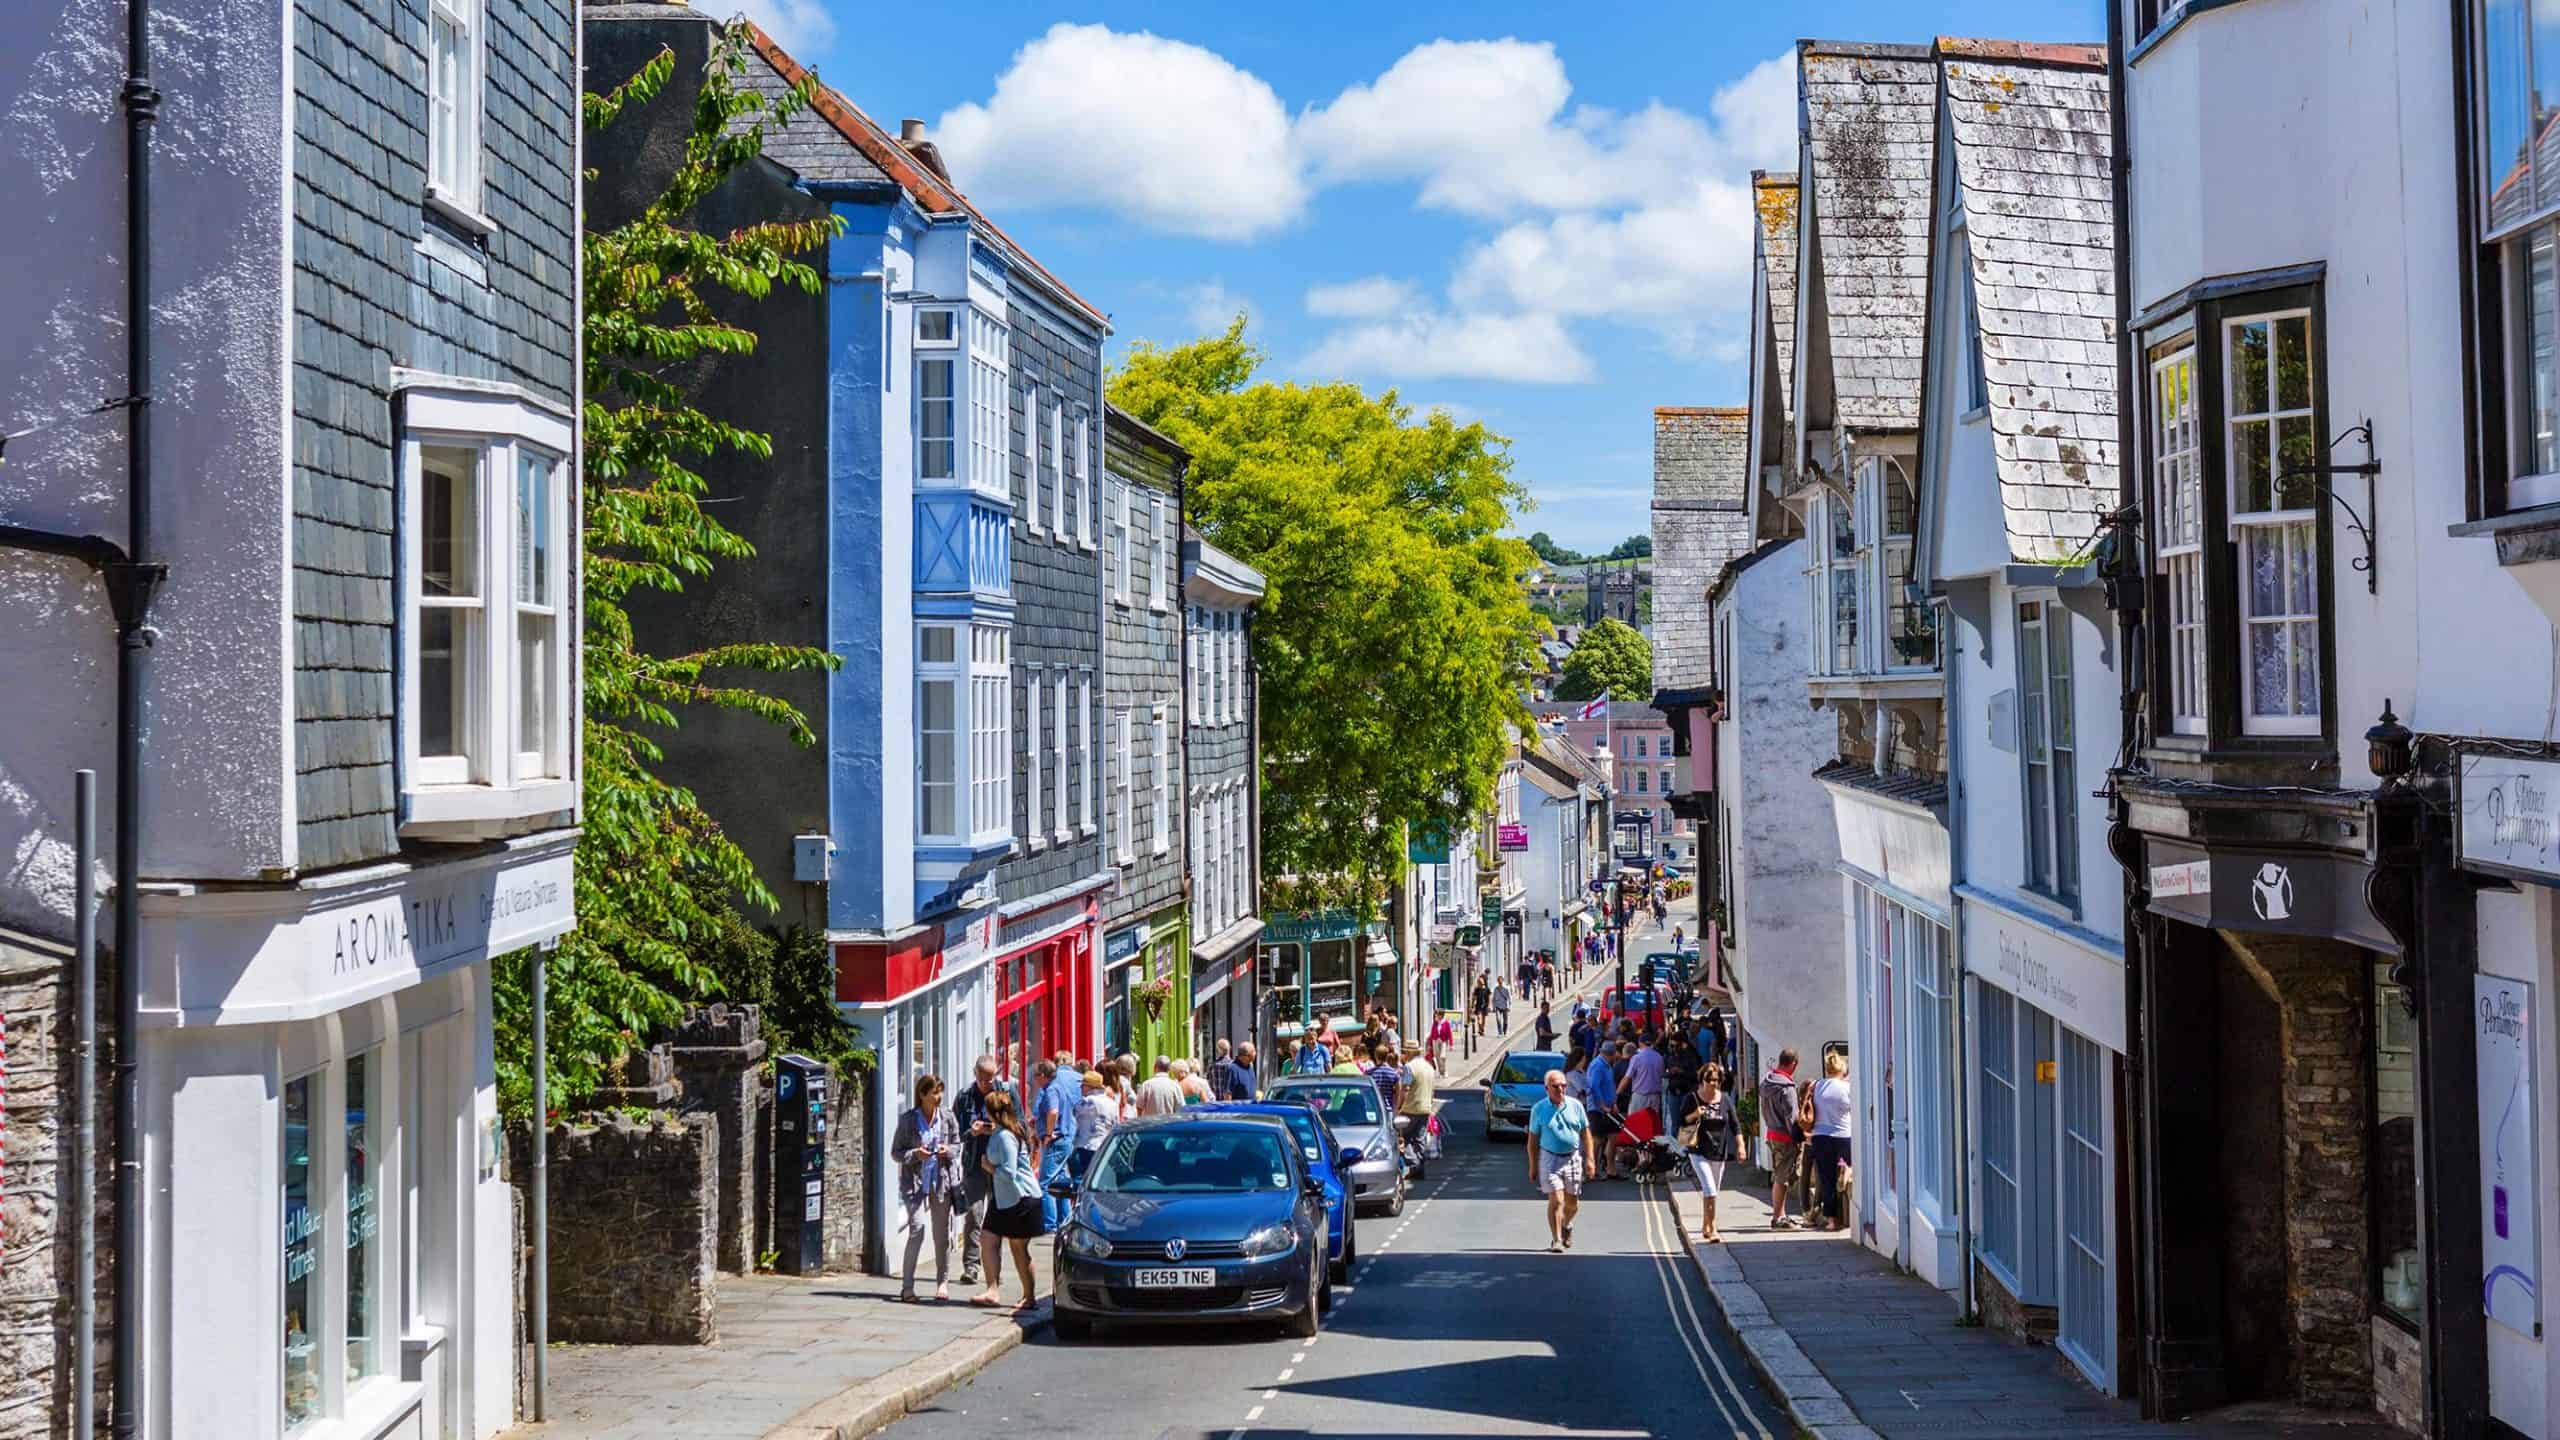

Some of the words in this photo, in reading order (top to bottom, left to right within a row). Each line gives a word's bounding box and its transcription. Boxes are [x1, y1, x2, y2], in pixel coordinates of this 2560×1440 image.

[333, 893, 456, 976] AROMATIKA
[780, 1075, 792, 1096] P
[1141, 1271, 1178, 1285] EK59
[1182, 1271, 1209, 1284] TNE
